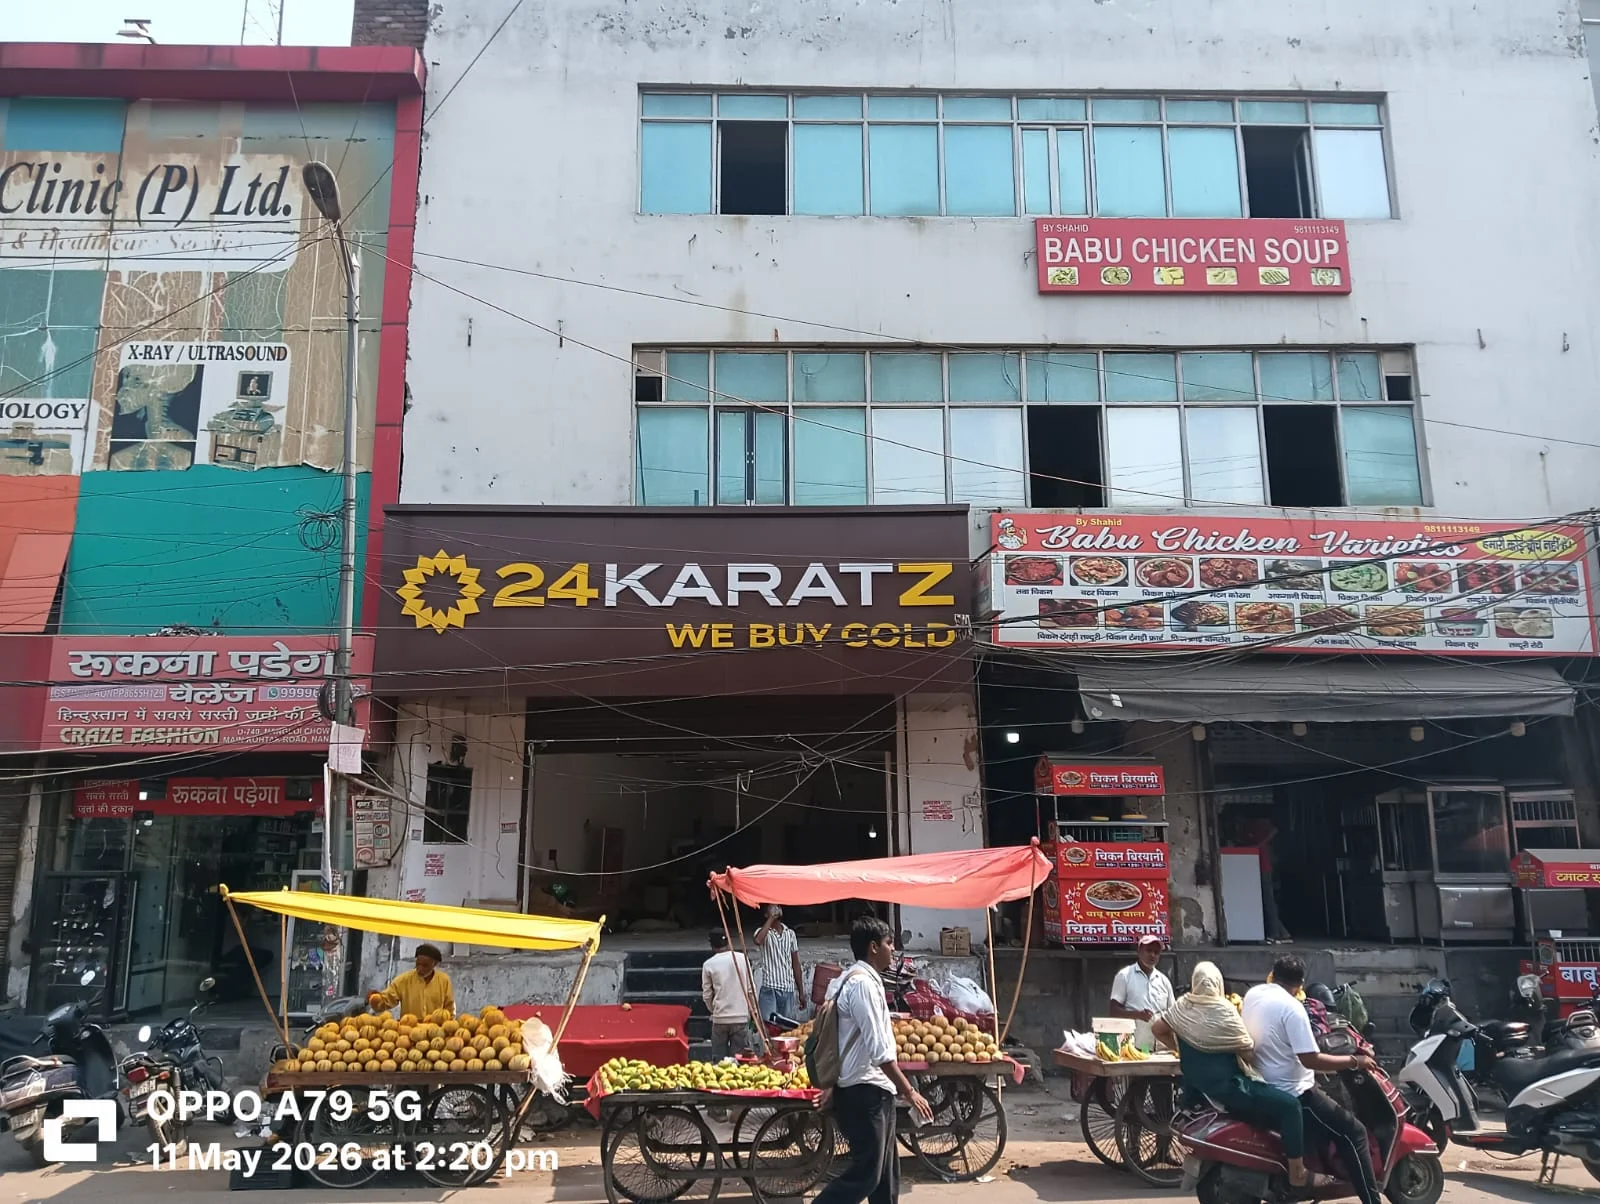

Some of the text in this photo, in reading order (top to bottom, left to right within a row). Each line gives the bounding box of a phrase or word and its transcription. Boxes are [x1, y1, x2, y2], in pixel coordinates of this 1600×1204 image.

[0, 162, 292, 228] Clinic (P) Ltd.
[1043, 224, 1089, 233] BY SHAHID
[1045, 237, 1340, 264] BABU CHICKEN SOUP
[128, 345, 174, 361] X-RAY
[187, 345, 288, 362] ULTRASOUND
[1076, 518, 1122, 527] By Shahid
[1424, 525, 1480, 534] 9811113149
[1035, 525, 1468, 557] Babu Chicken Varieties
[666, 622, 956, 648] WE BUY GOLD
[60, 728, 124, 744] CRAZE
